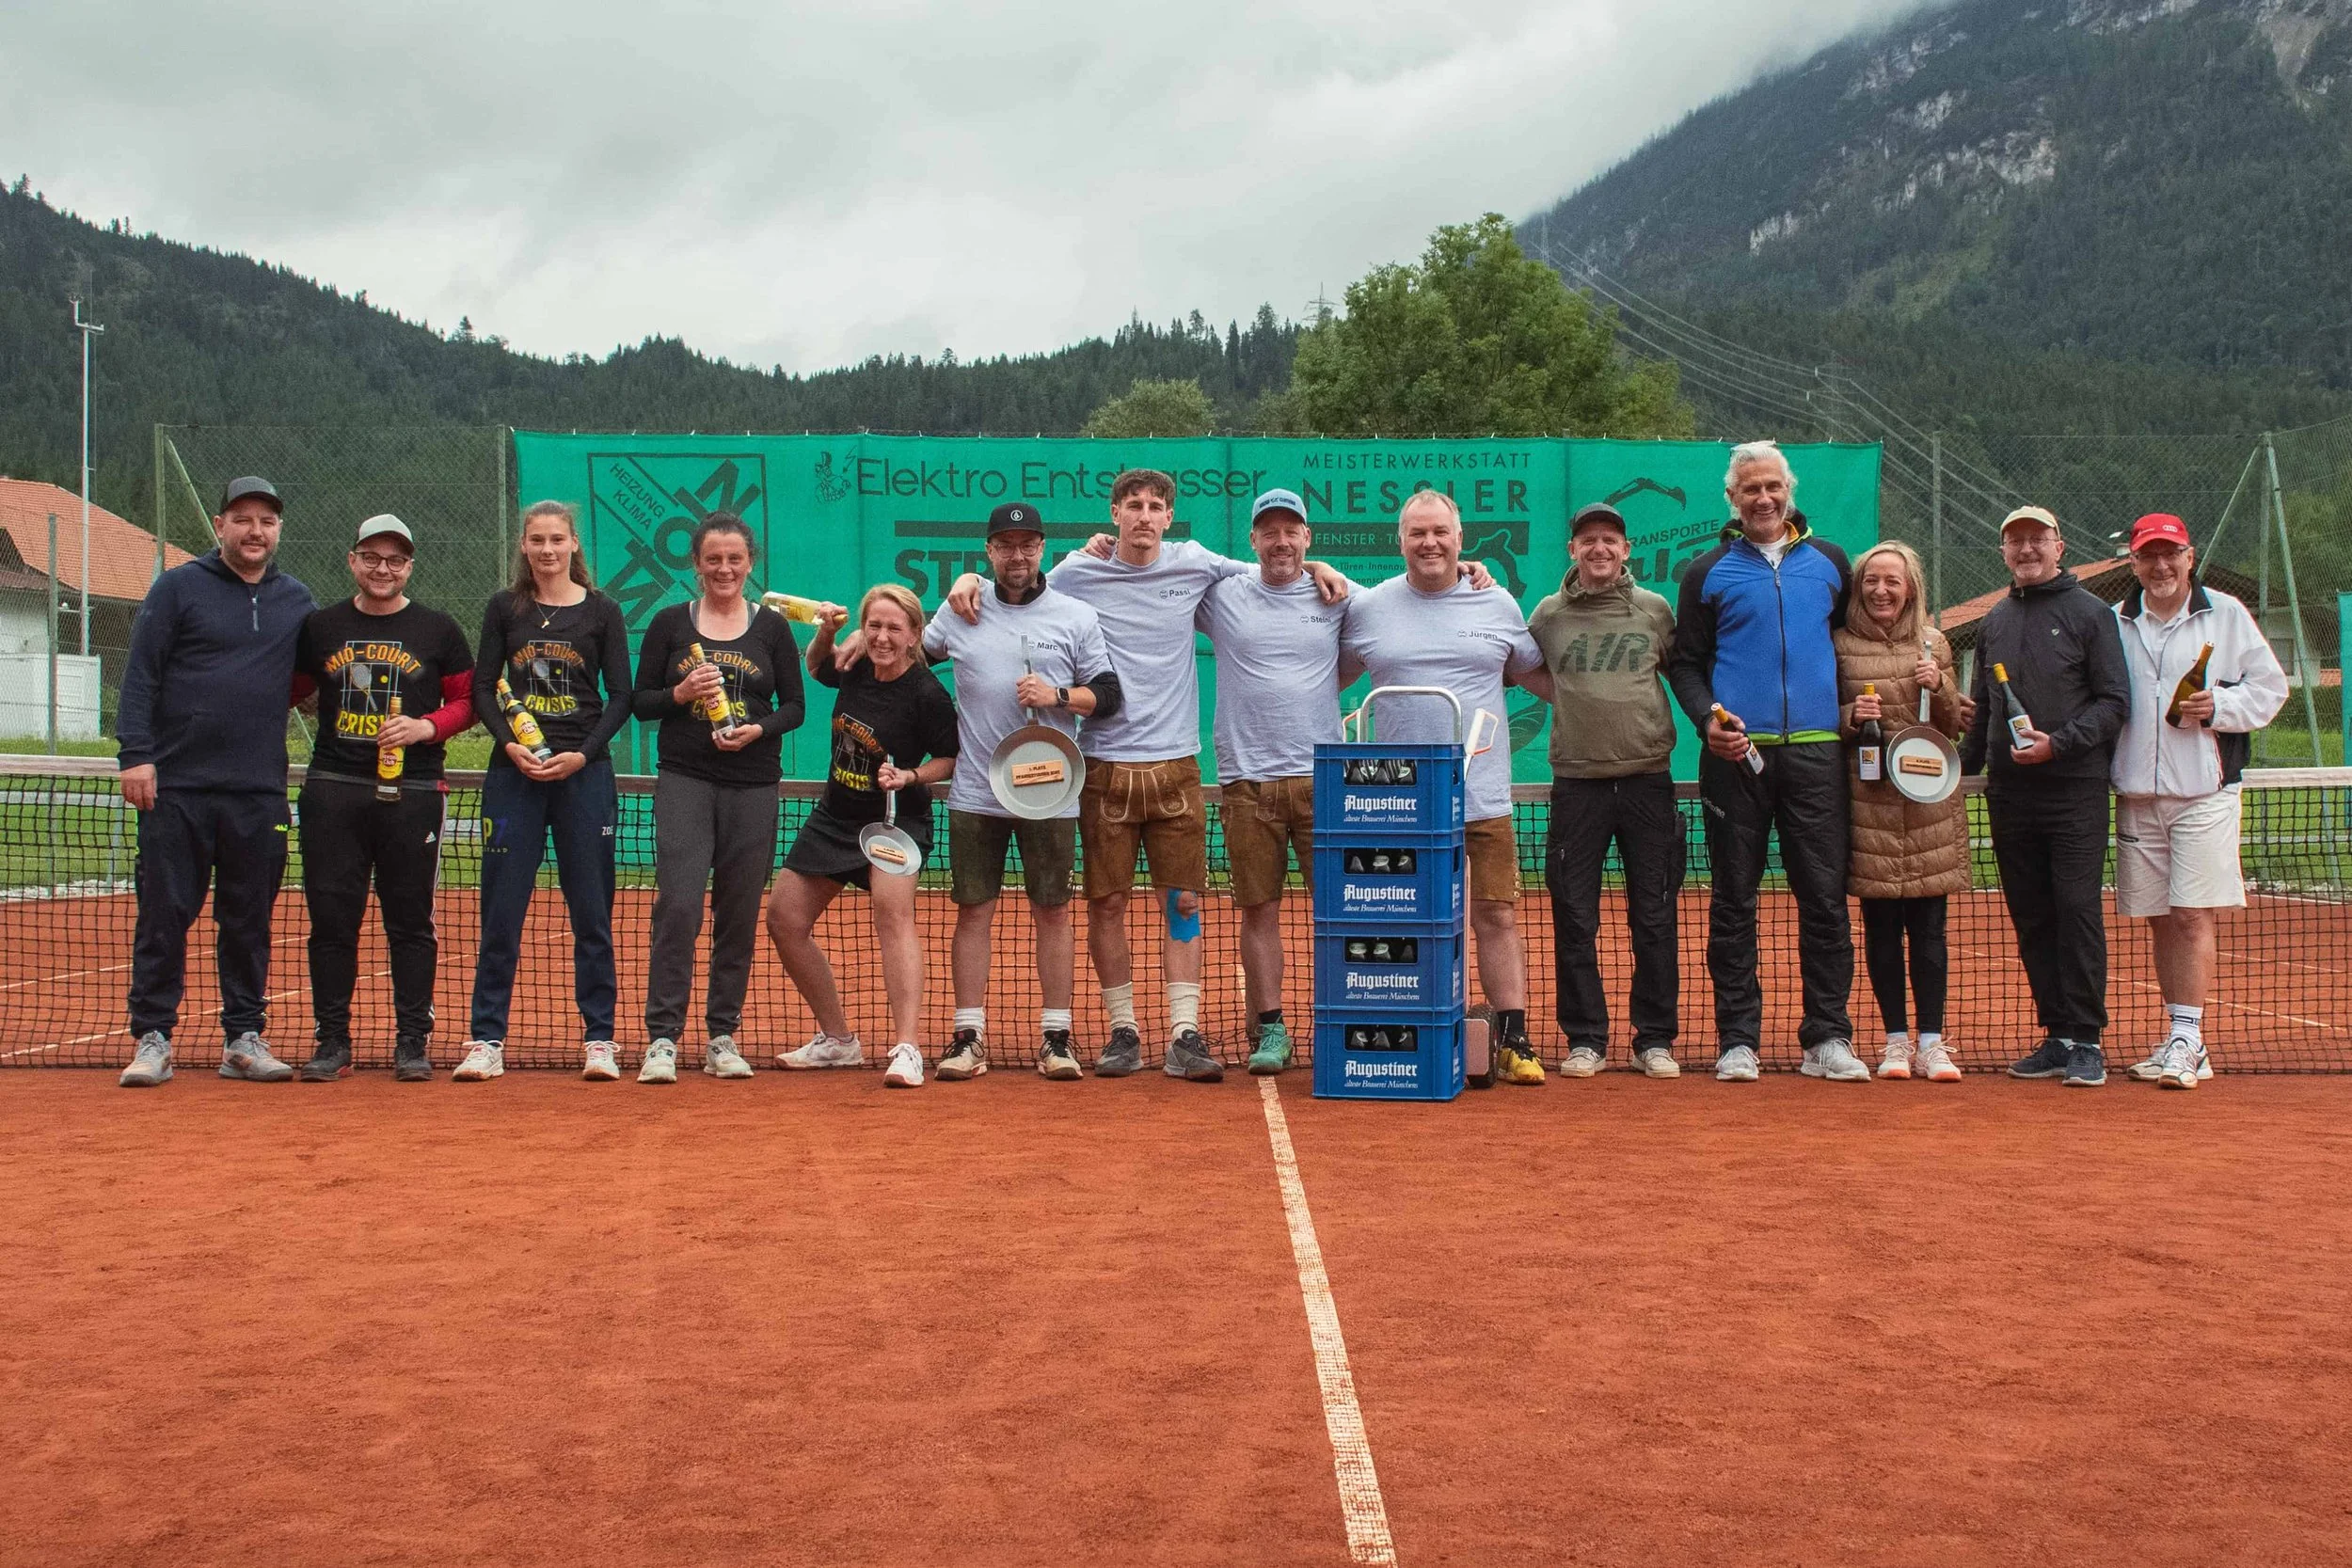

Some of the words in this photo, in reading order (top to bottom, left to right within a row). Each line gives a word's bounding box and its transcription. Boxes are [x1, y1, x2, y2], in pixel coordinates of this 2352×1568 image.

[1304, 452, 1532, 469] MEISTERWERKSTATT
[857, 458, 1008, 499] Elektro
[1022, 462, 1267, 499] Entssser
[610, 463, 666, 518] HEIZUNG
[613, 489, 653, 531] KLIMA
[1315, 533, 1375, 546] FENSTER
[1630, 519, 1720, 547] RANSPORTE
[513, 643, 585, 667] MID-COURT
[1037, 641, 1058, 651] Marc
[1557, 632, 1650, 673] AIR
[325, 644, 421, 673] MID-COURT
[677, 653, 759, 675] MI-COURT
[525, 694, 578, 713] CRISIS
[835, 767, 870, 790] RISIS
[1344, 795, 1417, 812] Augustiner
[1343, 883, 1417, 901] Augustiner
[1345, 972, 1419, 990] Augustiner
[1344, 1060, 1418, 1077] Augustiner
